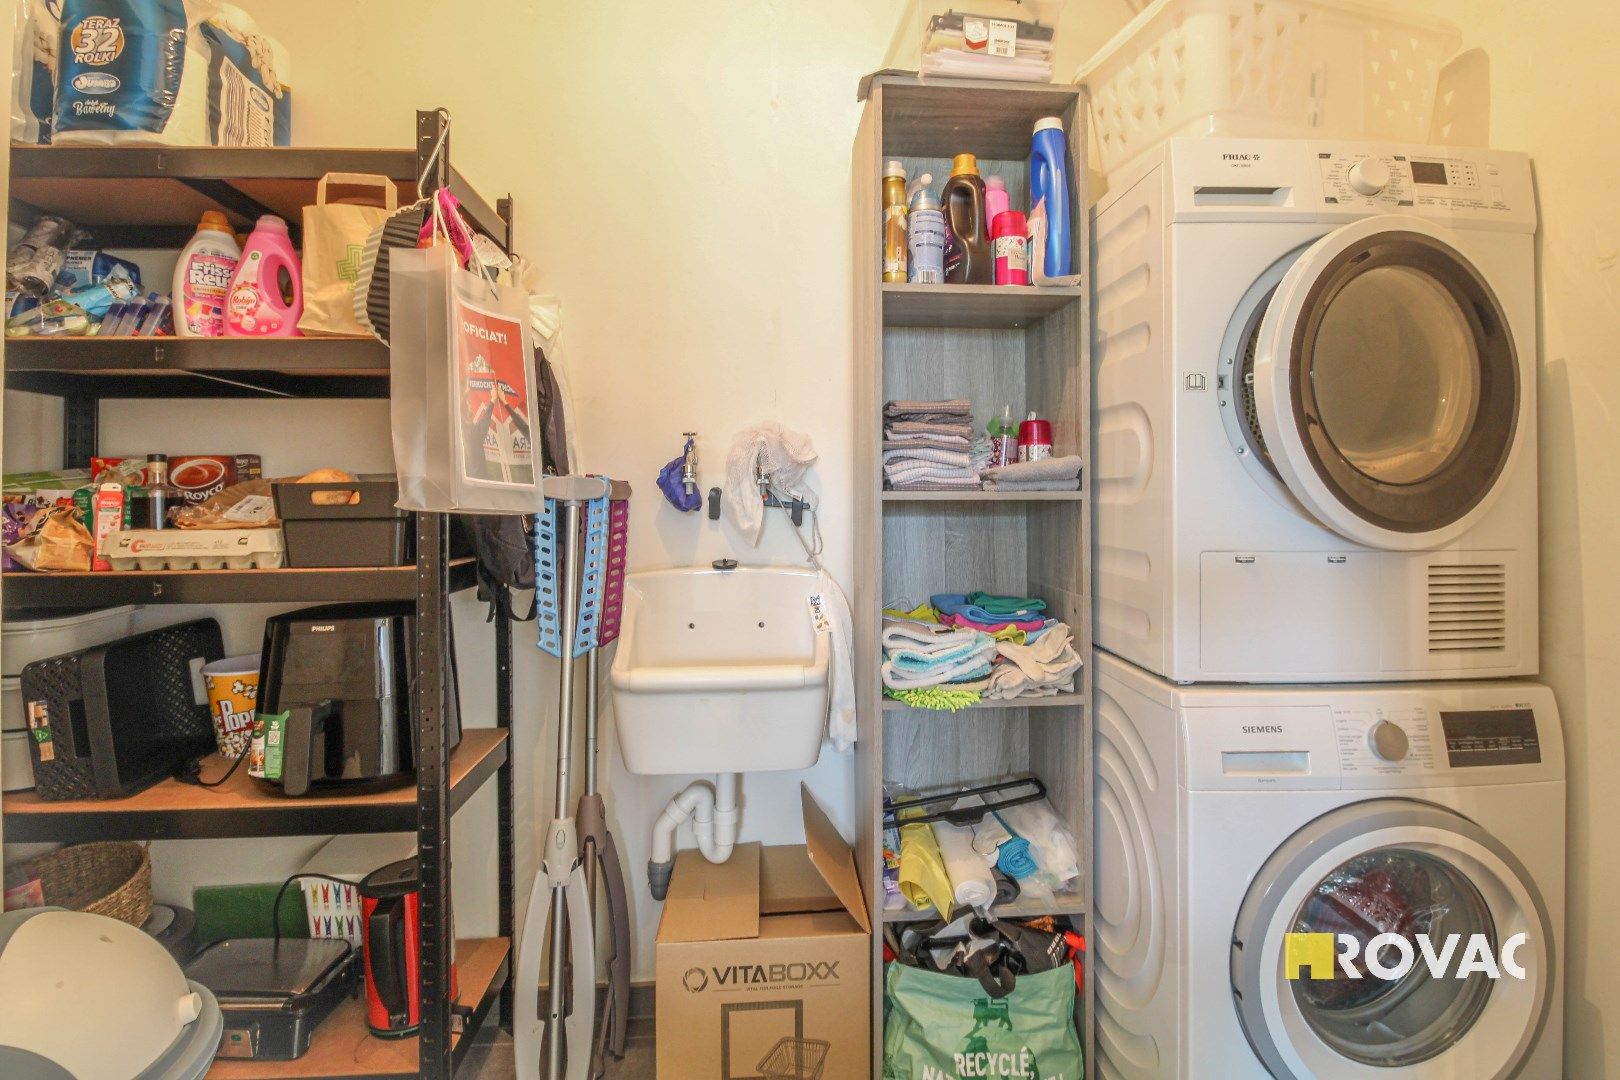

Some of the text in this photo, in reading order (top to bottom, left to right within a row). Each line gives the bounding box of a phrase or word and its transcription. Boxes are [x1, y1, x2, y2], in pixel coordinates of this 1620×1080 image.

[82, 18, 120, 29] TERAZ
[75, 27, 120, 54] 32
[74, 51, 115, 64] ROLKI
[191, 261, 231, 278] Friss
[189, 269, 228, 288] Reu
[184, 483, 223, 501] Royco
[1242, 725, 1283, 734] SIEMENS
[712, 961, 840, 985] VITABOXX
